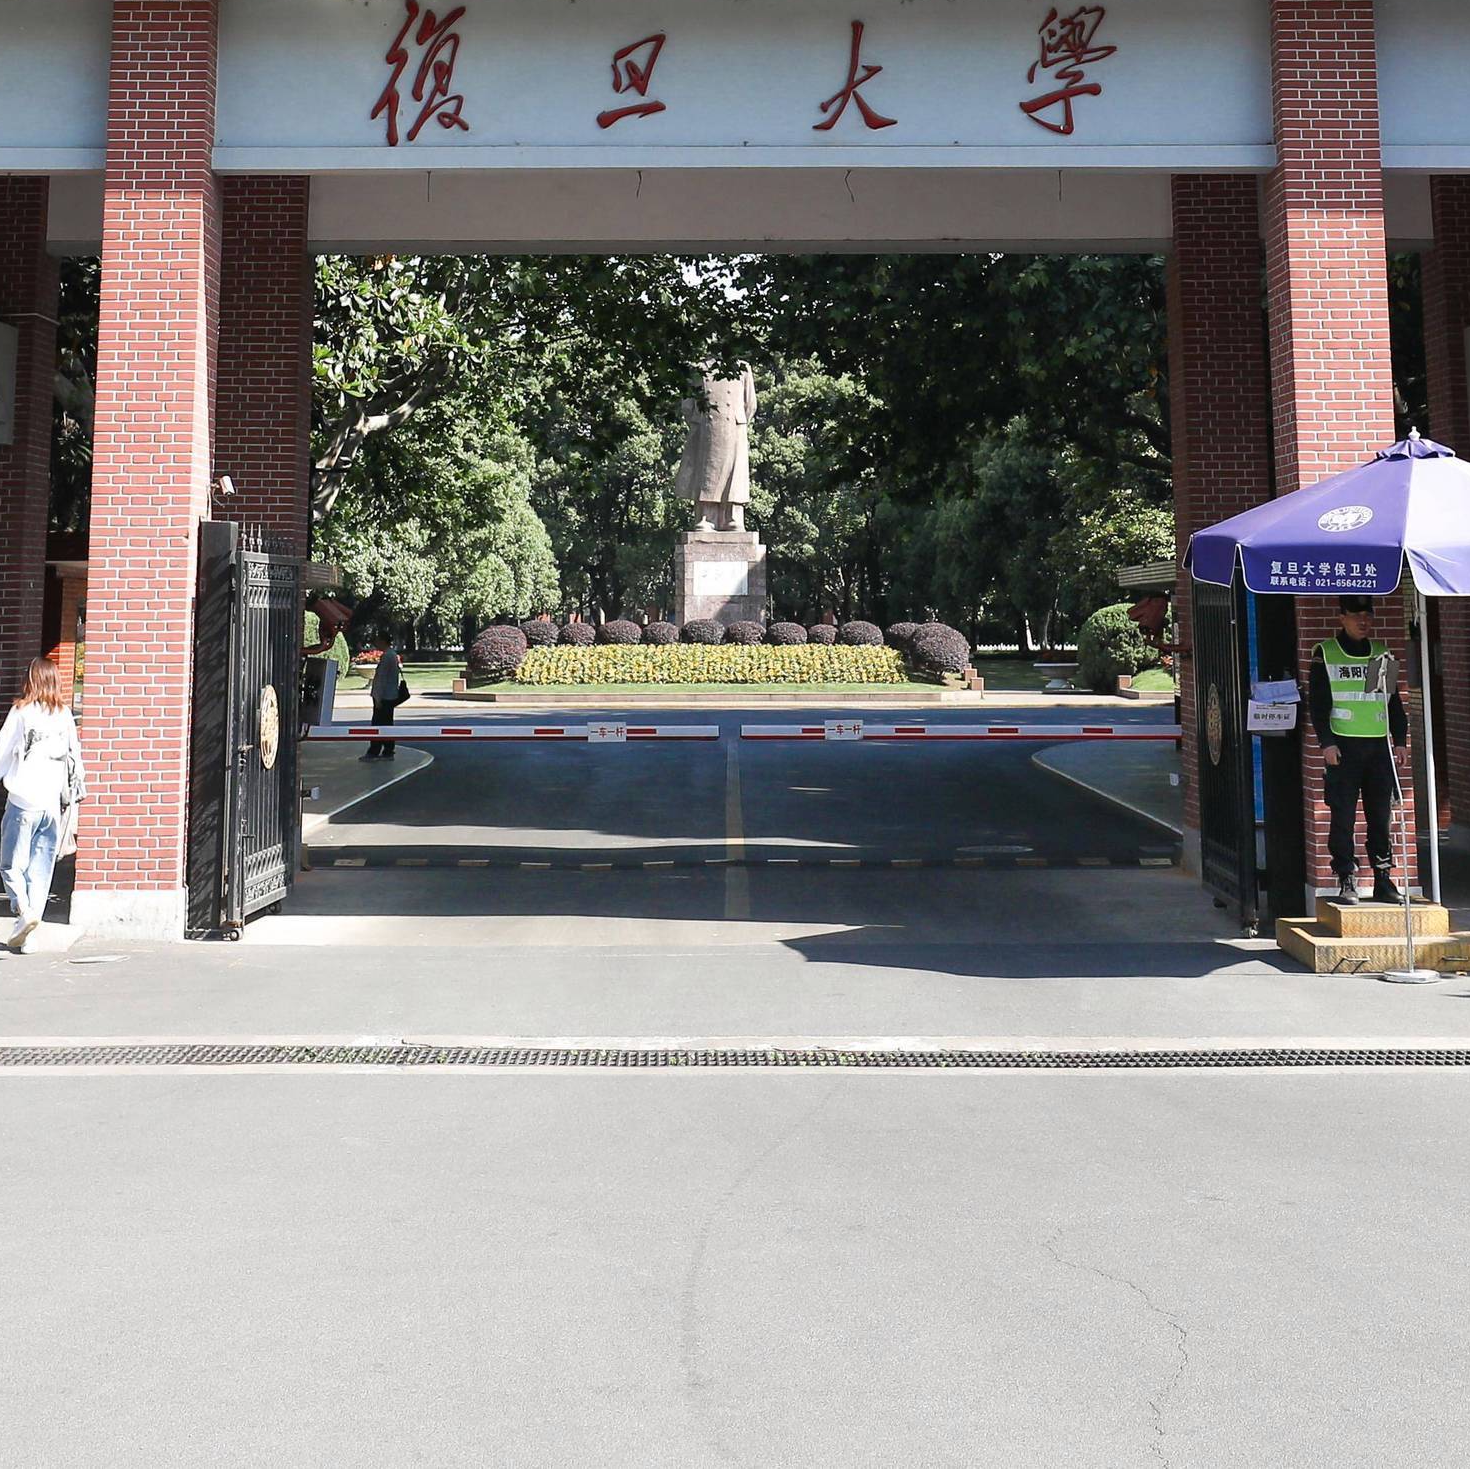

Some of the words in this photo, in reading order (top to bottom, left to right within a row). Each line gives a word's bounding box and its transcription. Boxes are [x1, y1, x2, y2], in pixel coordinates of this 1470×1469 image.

[1270, 560, 1378, 577] 复旦大学保卫处
